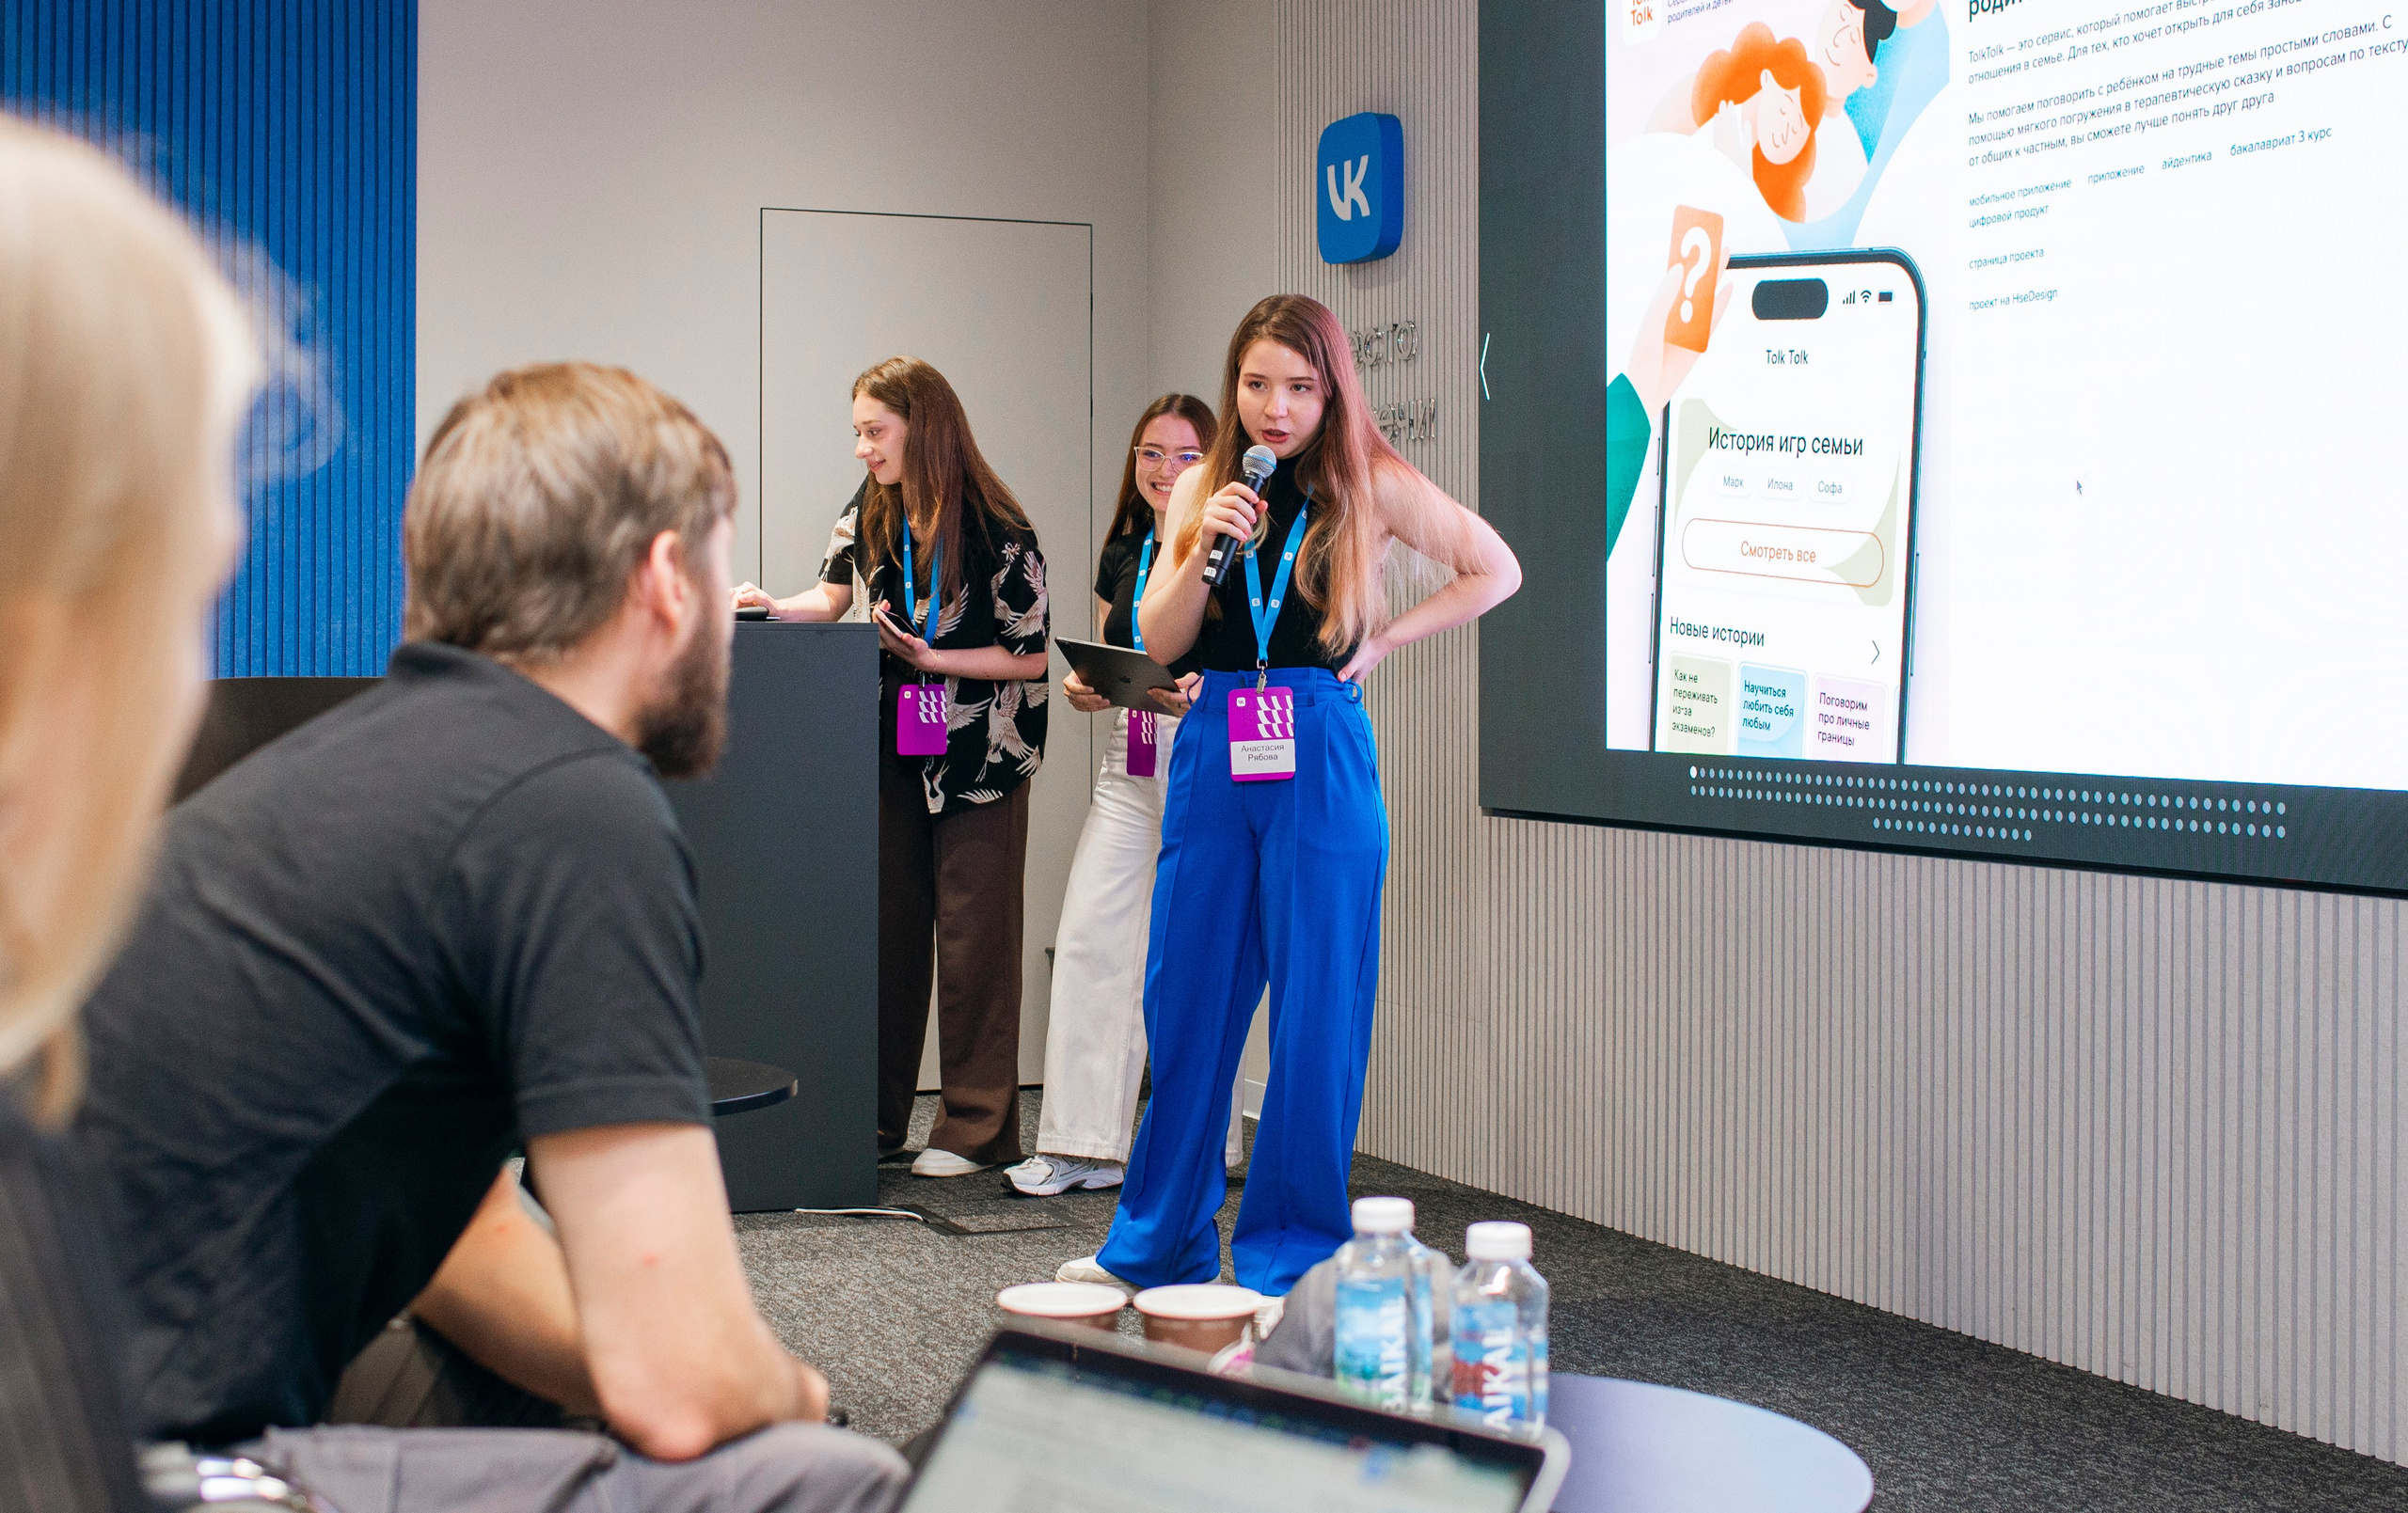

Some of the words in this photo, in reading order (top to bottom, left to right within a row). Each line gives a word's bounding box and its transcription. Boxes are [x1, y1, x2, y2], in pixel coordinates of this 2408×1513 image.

[1631, 7, 1653, 25] Tolk
[1668, 2, 1704, 25] родителей
[1969, 45, 2004, 63] TolkTolk
[2019, 39, 2034, 50] это
[2036, 29, 2073, 45] сервис,
[2077, 14, 2120, 35] который
[2124, 2, 2173, 23] помогает
[1969, 63, 2021, 84] отношения
[2024, 61, 2029, 70] в
[2033, 53, 2065, 68] семье.
[2067, 46, 2087, 61] Для
[2091, 41, 2109, 53] тех,
[2113, 37, 2130, 48] кто
[2132, 29, 2161, 43] хочет
[2165, 19, 2210, 35] открыть
[2212, 11, 2233, 25] для
[2237, 0, 2264, 17] себя
[1969, 113, 1984, 125] Мы
[1988, 102, 2034, 120] помогаем
[2037, 89, 2095, 109] поговорить
[2098, 86, 2103, 95] с
[2107, 73, 2159, 97] ребёнком
[2162, 70, 2174, 80] на
[2178, 57, 2224, 79] трудные
[2228, 50, 2257, 65] темы
[2260, 36, 2318, 59] простыми
[2322, 23, 2378, 43] словами.
[2383, 15, 2391, 29] С
[1970, 128, 2014, 146] помощью
[2018, 118, 2057, 134] мягкого
[2060, 103, 2121, 125] погружения
[2125, 102, 2131, 111] в
[2134, 79, 2230, 109] терапевтическую
[2234, 70, 2273, 87] сказку
[2276, 68, 2282, 77] и
[2287, 53, 2345, 75] вопросам
[2350, 49, 2364, 61] по
[2368, 39, 2408, 56] тексту
[1969, 156, 1979, 166] от
[1982, 150, 2012, 164] общих
[2016, 148, 2020, 156] к
[2023, 138, 2067, 153] частным,
[2071, 134, 2083, 145] вы
[2087, 124, 2131, 141] сможете
[2134, 116, 2168, 134] лучше
[2172, 108, 2210, 123] понять
[2212, 101, 2238, 117] друг
[2242, 92, 2273, 110] друга
[1970, 191, 2015, 206] мобильное
[2018, 180, 2071, 197] приложение
[2088, 165, 2145, 184] приложение
[2162, 151, 2211, 169] айдентика
[2230, 134, 2295, 156] бакалавриат
[2299, 130, 2305, 142] 3
[2308, 128, 2332, 142] курс
[1327, 154, 1370, 221] VK
[1970, 211, 2012, 228] цифровой
[2015, 205, 2049, 219] продукт
[1970, 256, 2007, 269] страница
[2010, 249, 2044, 262] проекта
[1970, 298, 1998, 311] проект
[2013, 290, 2058, 303] HseDesign
[1766, 349, 1785, 364] Tolk
[1789, 349, 1808, 364] Tolk
[1709, 426, 1774, 456] История
[1780, 435, 1807, 458] игр
[1812, 436, 1862, 455] семьи
[1723, 476, 1744, 489] Марк
[1768, 479, 1793, 490] Илона
[1818, 481, 1842, 496] Софа
[1741, 541, 1794, 562] Смотреть
[1797, 550, 1815, 562] все
[1671, 616, 1708, 638] Новые
[1713, 627, 1764, 648] истории
[1674, 670, 1687, 682] Как
[1688, 674, 1698, 683] не
[1673, 688, 1718, 703] переживать
[1744, 679, 1786, 699] Научиться
[1672, 705, 1692, 717] из-за
[1742, 699, 1773, 715] любить
[1774, 702, 1794, 717] себя
[1820, 692, 1867, 712] Поговорим
[1672, 722, 1715, 737] экзаменов?
[1742, 717, 1770, 731] любым
[1818, 714, 1834, 726] про
[1836, 717, 1870, 730] личные
[1242, 744, 1285, 753] Анастасия
[1818, 732, 1854, 747] границы
[1248, 753, 1278, 762] Рябова
